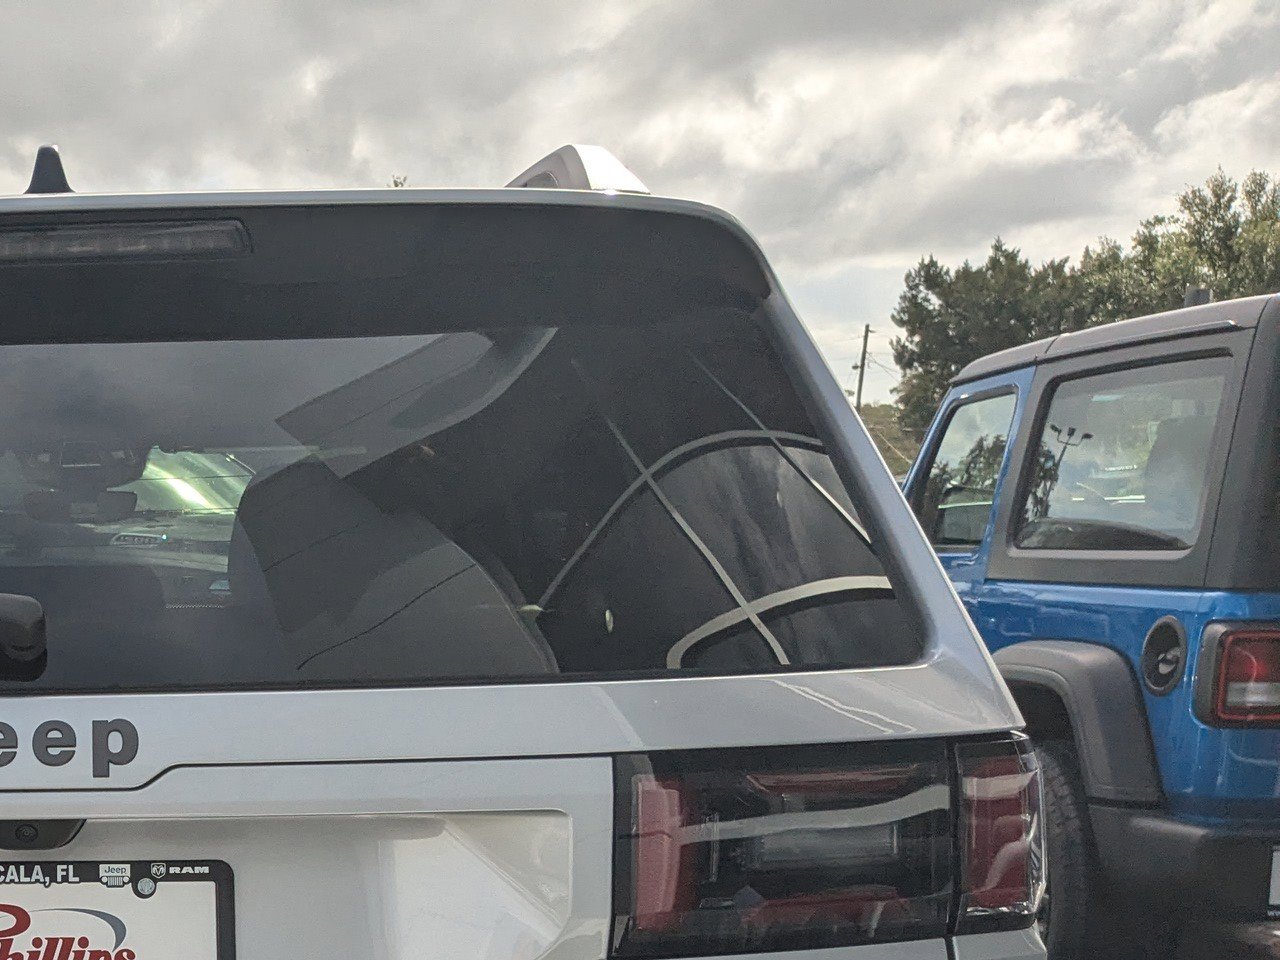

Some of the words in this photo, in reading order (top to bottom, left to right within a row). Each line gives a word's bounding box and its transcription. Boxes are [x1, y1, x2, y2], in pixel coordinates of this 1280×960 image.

[56, 865, 79, 882] FL
[104, 866, 127, 875] Jeep
[169, 866, 210, 874] RAM
